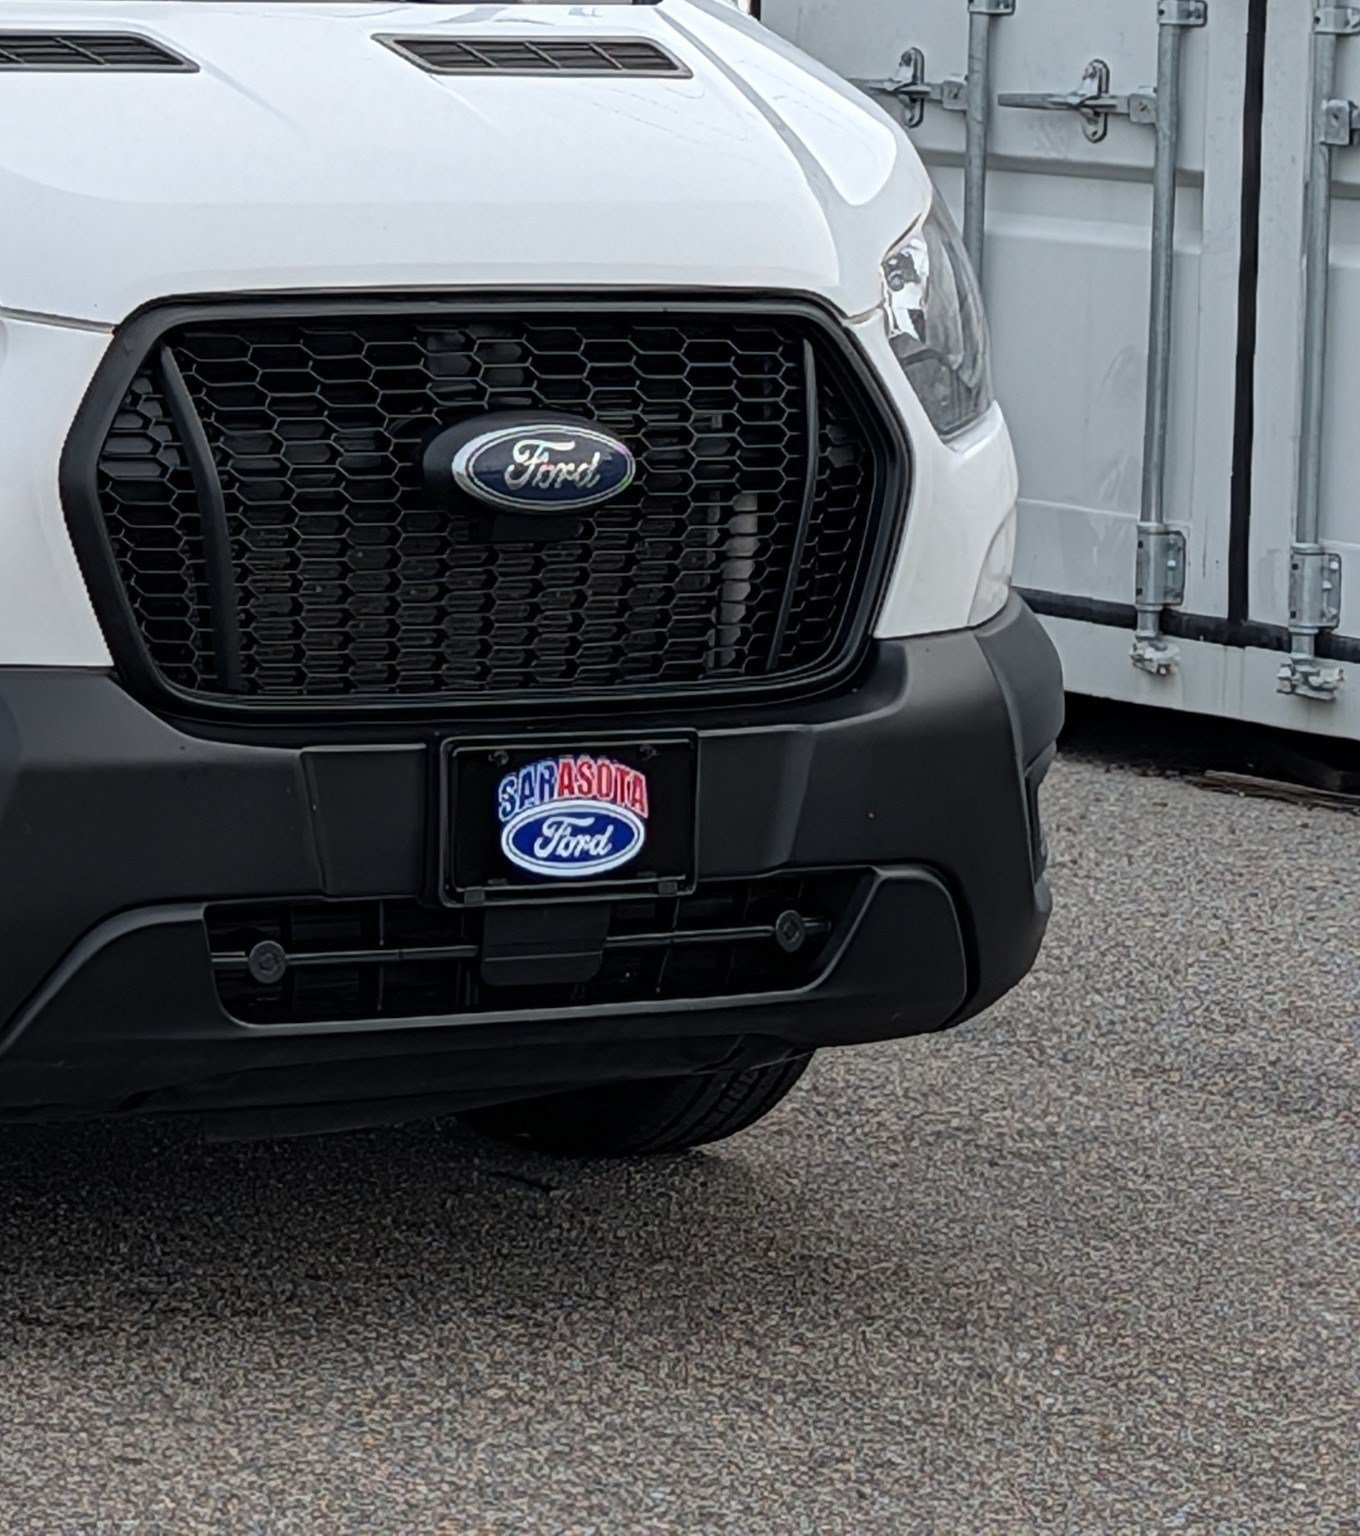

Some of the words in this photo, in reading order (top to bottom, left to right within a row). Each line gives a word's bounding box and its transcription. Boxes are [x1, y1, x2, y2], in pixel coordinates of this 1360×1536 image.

[503, 438, 601, 491] Ford
[498, 754, 649, 822] SARASOTA
[533, 815, 615, 859] Ford
